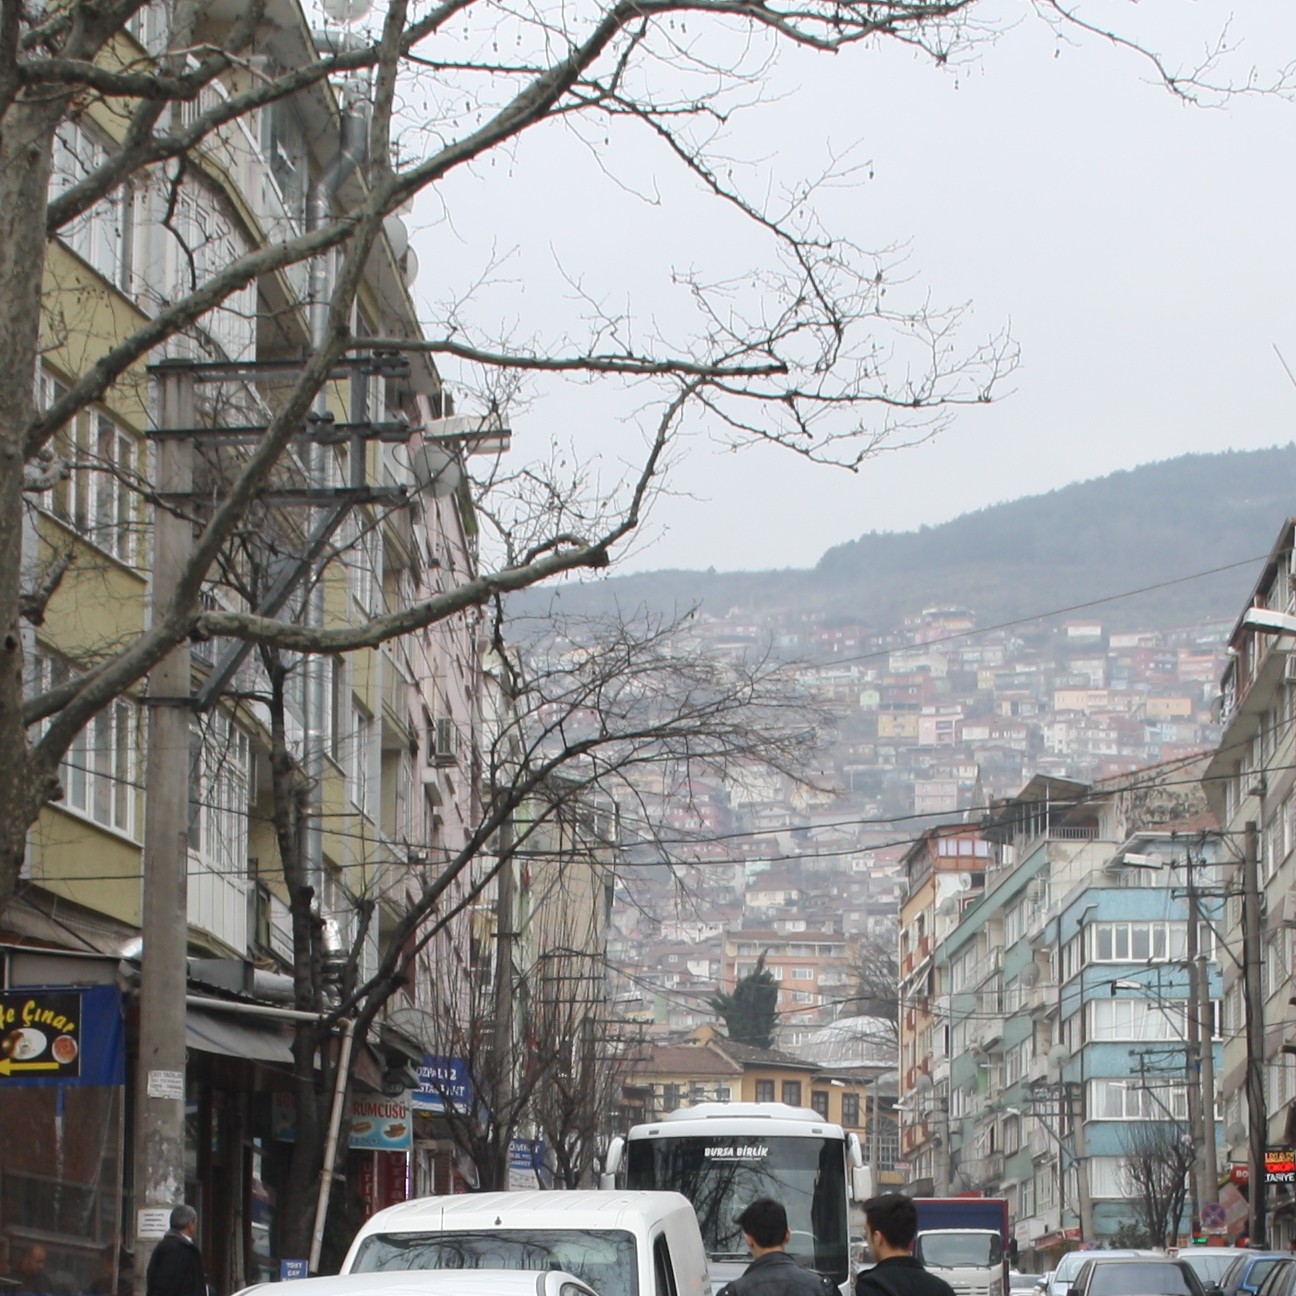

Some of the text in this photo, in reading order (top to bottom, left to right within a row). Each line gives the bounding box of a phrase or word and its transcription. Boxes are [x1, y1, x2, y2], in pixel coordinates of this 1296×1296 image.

[21, 999, 75, 1033] Çınar
[704, 1144, 769, 1157] BURSA BİRLİK
